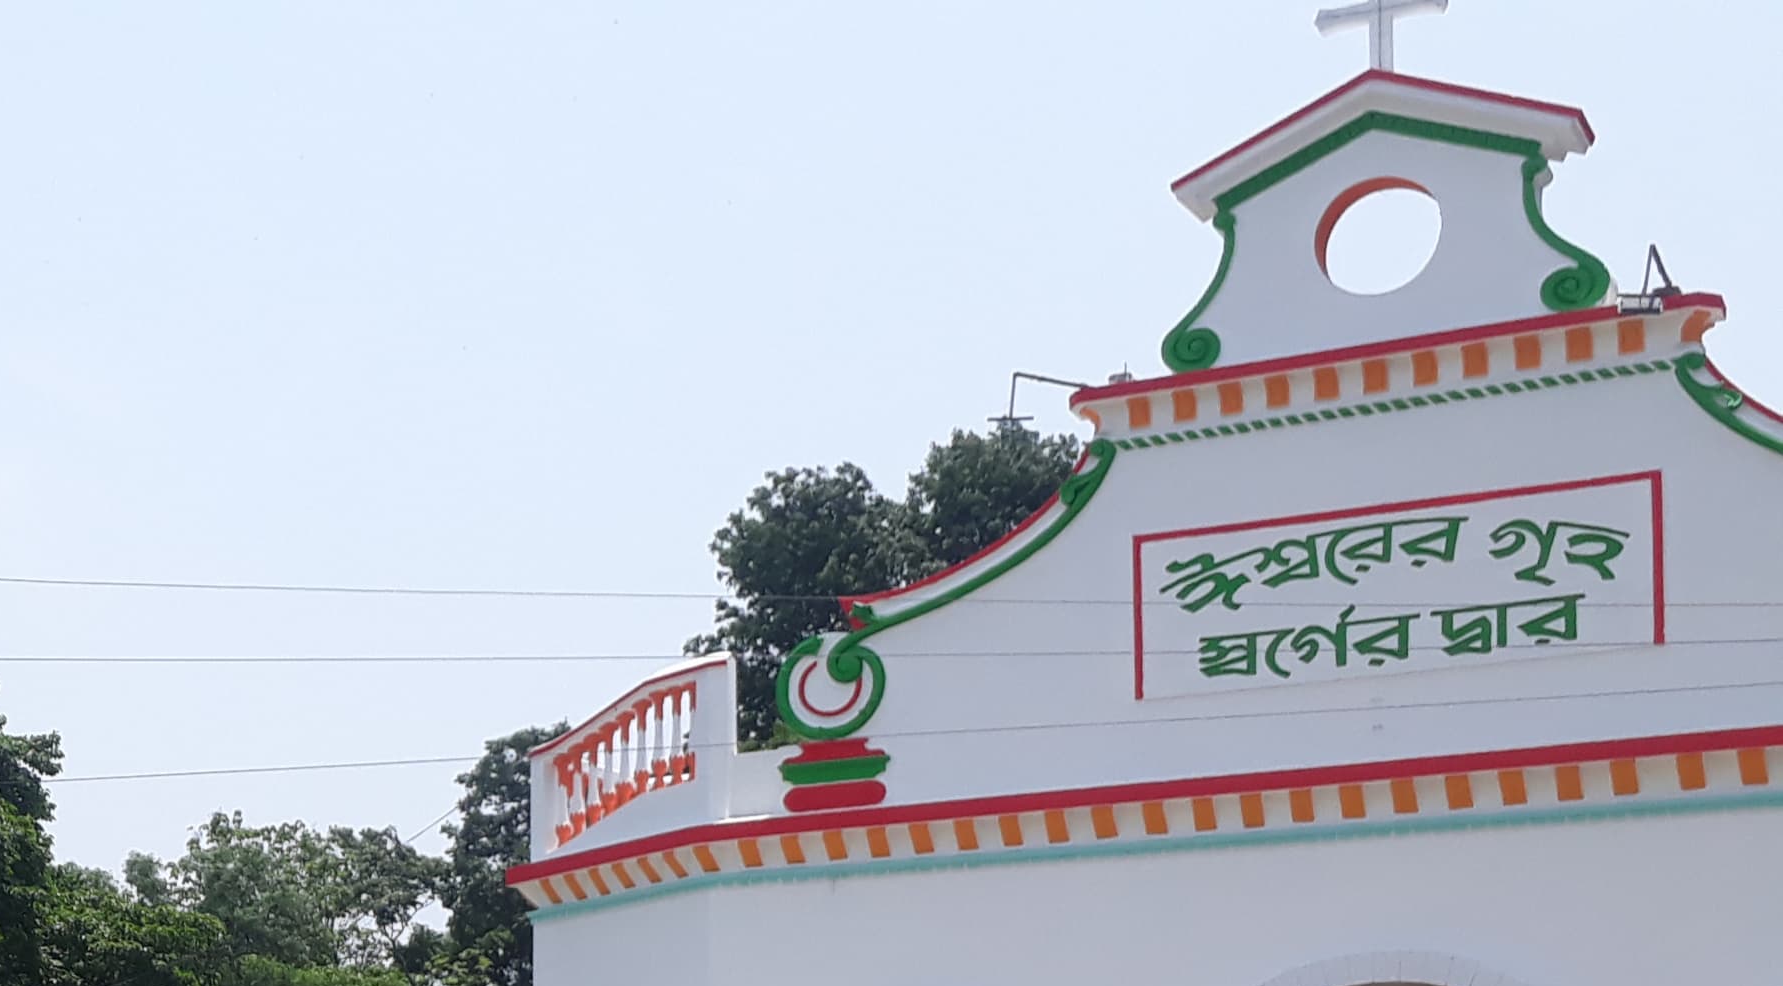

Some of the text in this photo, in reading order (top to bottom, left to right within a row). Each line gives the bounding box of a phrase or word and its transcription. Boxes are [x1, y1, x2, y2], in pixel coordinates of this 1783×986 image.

[1489, 519, 1630, 586] গৃহ
[1198, 594, 1586, 678] স্বর্গের দ্বার
